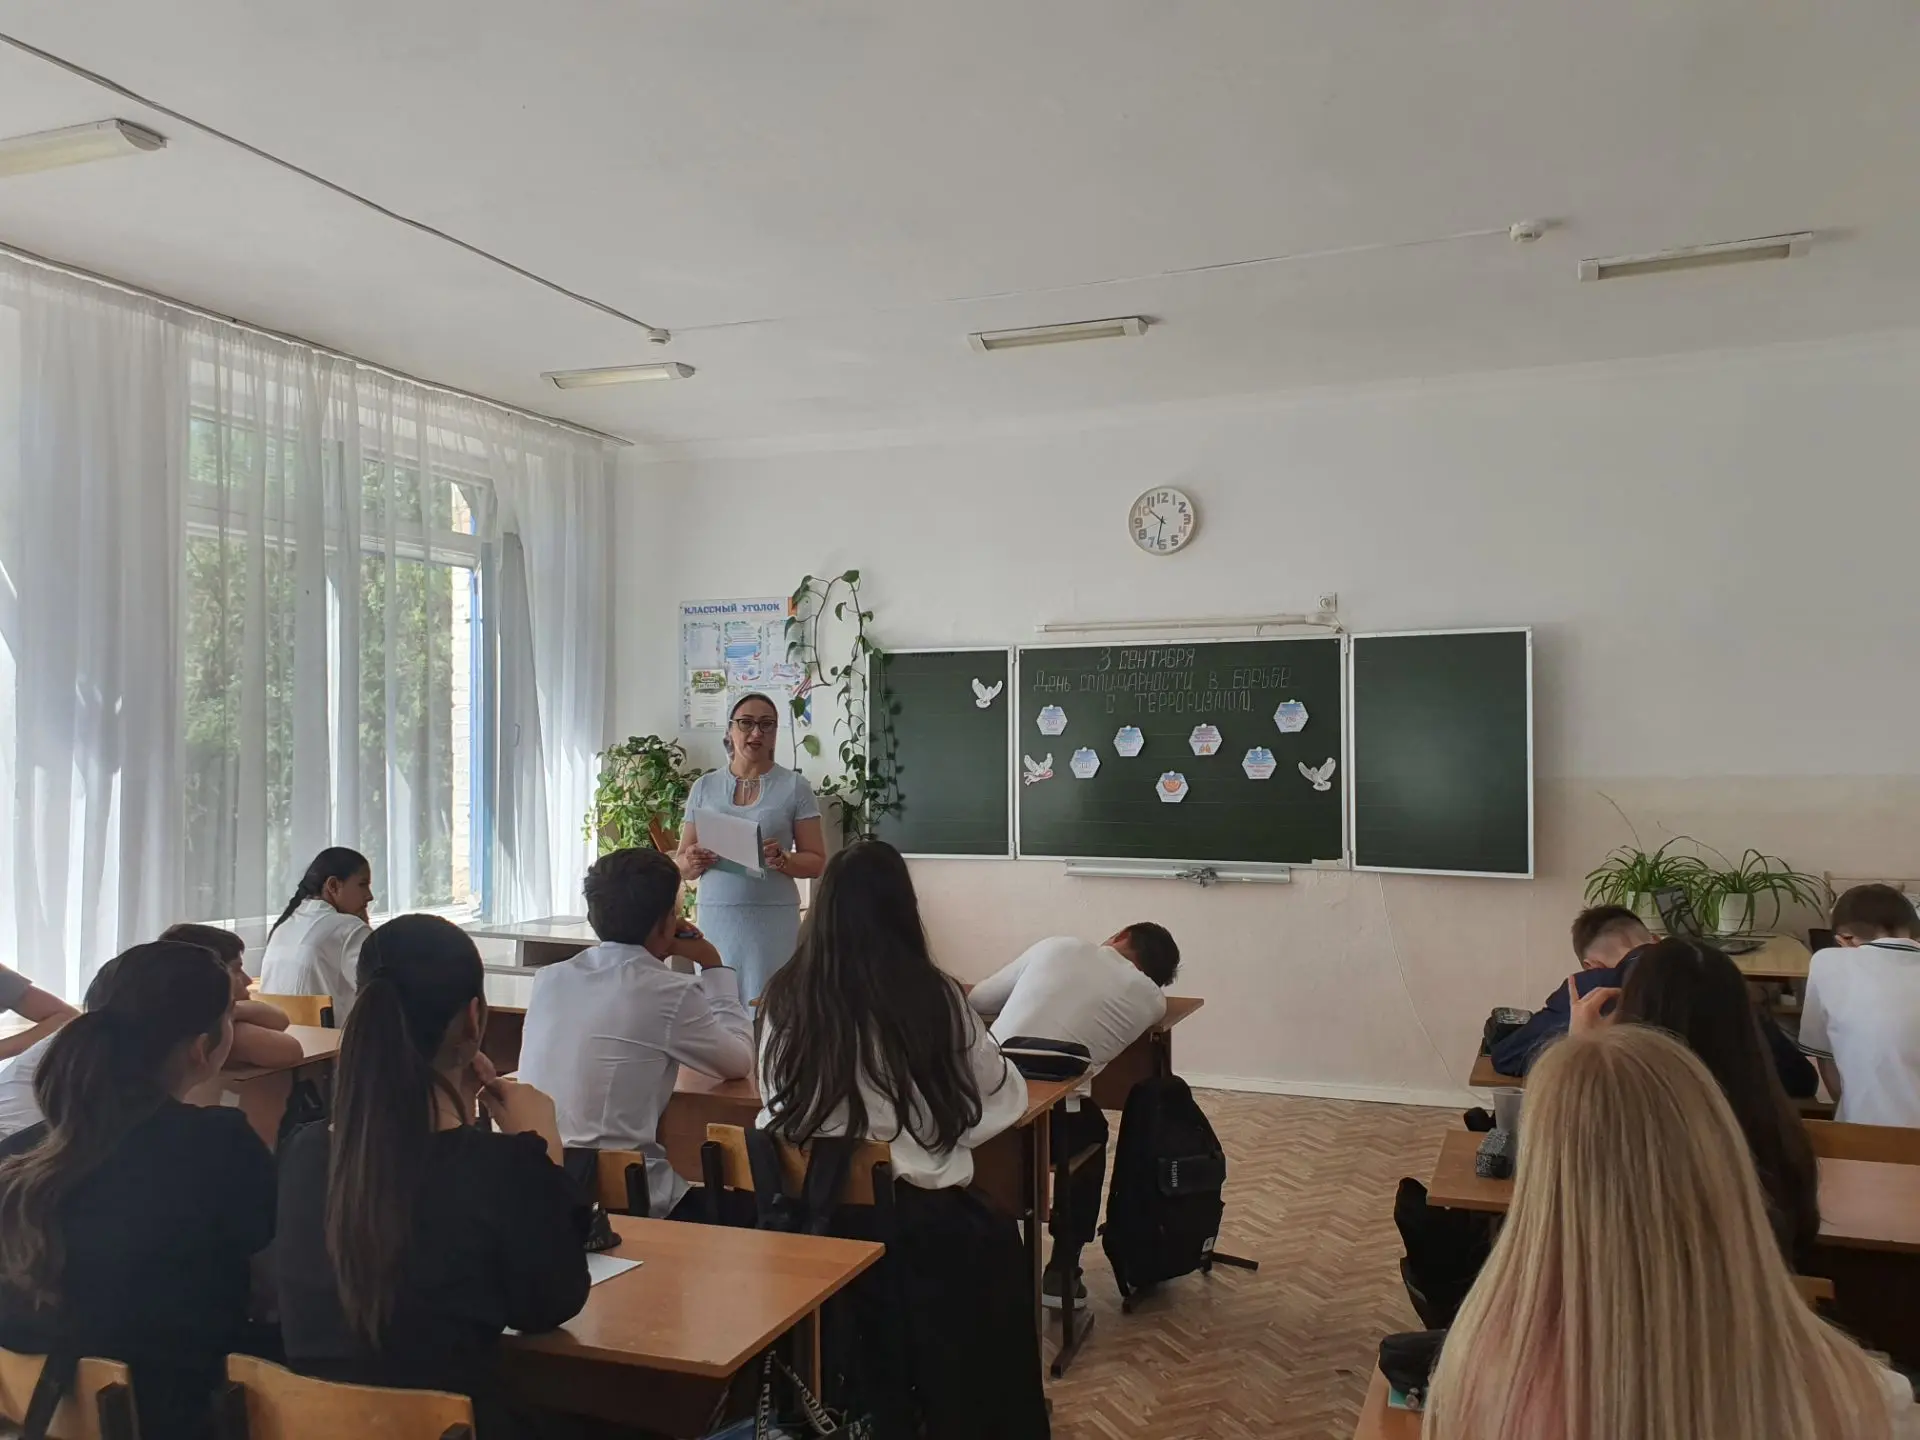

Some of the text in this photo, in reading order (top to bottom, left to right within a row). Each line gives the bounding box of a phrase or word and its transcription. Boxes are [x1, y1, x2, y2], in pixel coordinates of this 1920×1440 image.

[1147, 496, 1155, 507] 11
[1157, 492, 1169, 504] 12
[1172, 494, 1176, 506] 1
[1138, 506, 1150, 516] 10
[1178, 501, 1186, 513] 2
[1134, 517, 1143, 528] 9
[1183, 513, 1192, 525] 3
[1138, 529, 1147, 540] 8
[1170, 534, 1179, 546] 5
[1148, 536, 1156, 548] 7
[1158, 539, 1167, 550] 6
[684, 603, 780, 615] КЛАССНЫЙ УГОЛОК
[1097, 647, 1196, 672] 3 СЕНТЯБРЯ
[1080, 671, 1194, 692] СОЛИДАРНОСТИ
[1233, 666, 1291, 689] БОРЬБЕ
